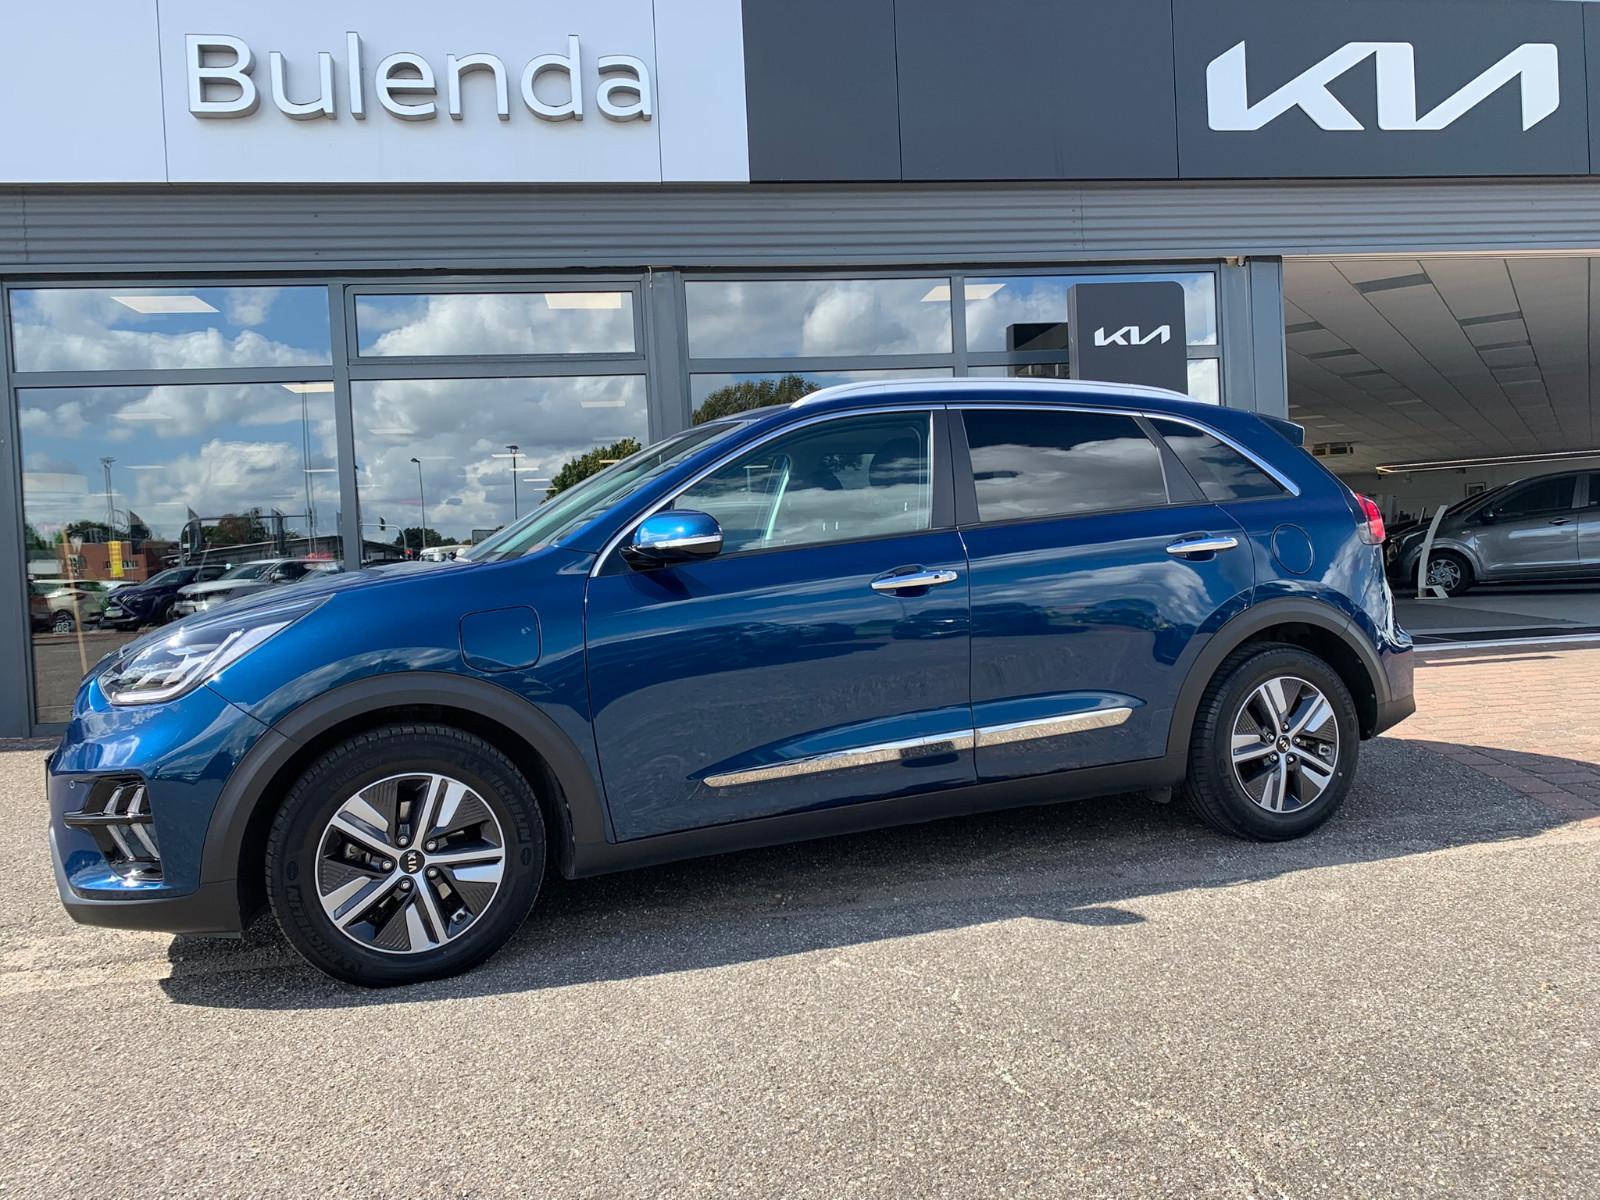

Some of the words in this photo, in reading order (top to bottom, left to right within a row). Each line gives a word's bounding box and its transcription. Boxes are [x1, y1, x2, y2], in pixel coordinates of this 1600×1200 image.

[184, 31, 653, 122] Bulenda
[1206, 40, 1560, 132] KIA
[1093, 324, 1171, 347] KIA
[1279, 737, 1290, 752] KIA
[407, 851, 417, 873] KIA
